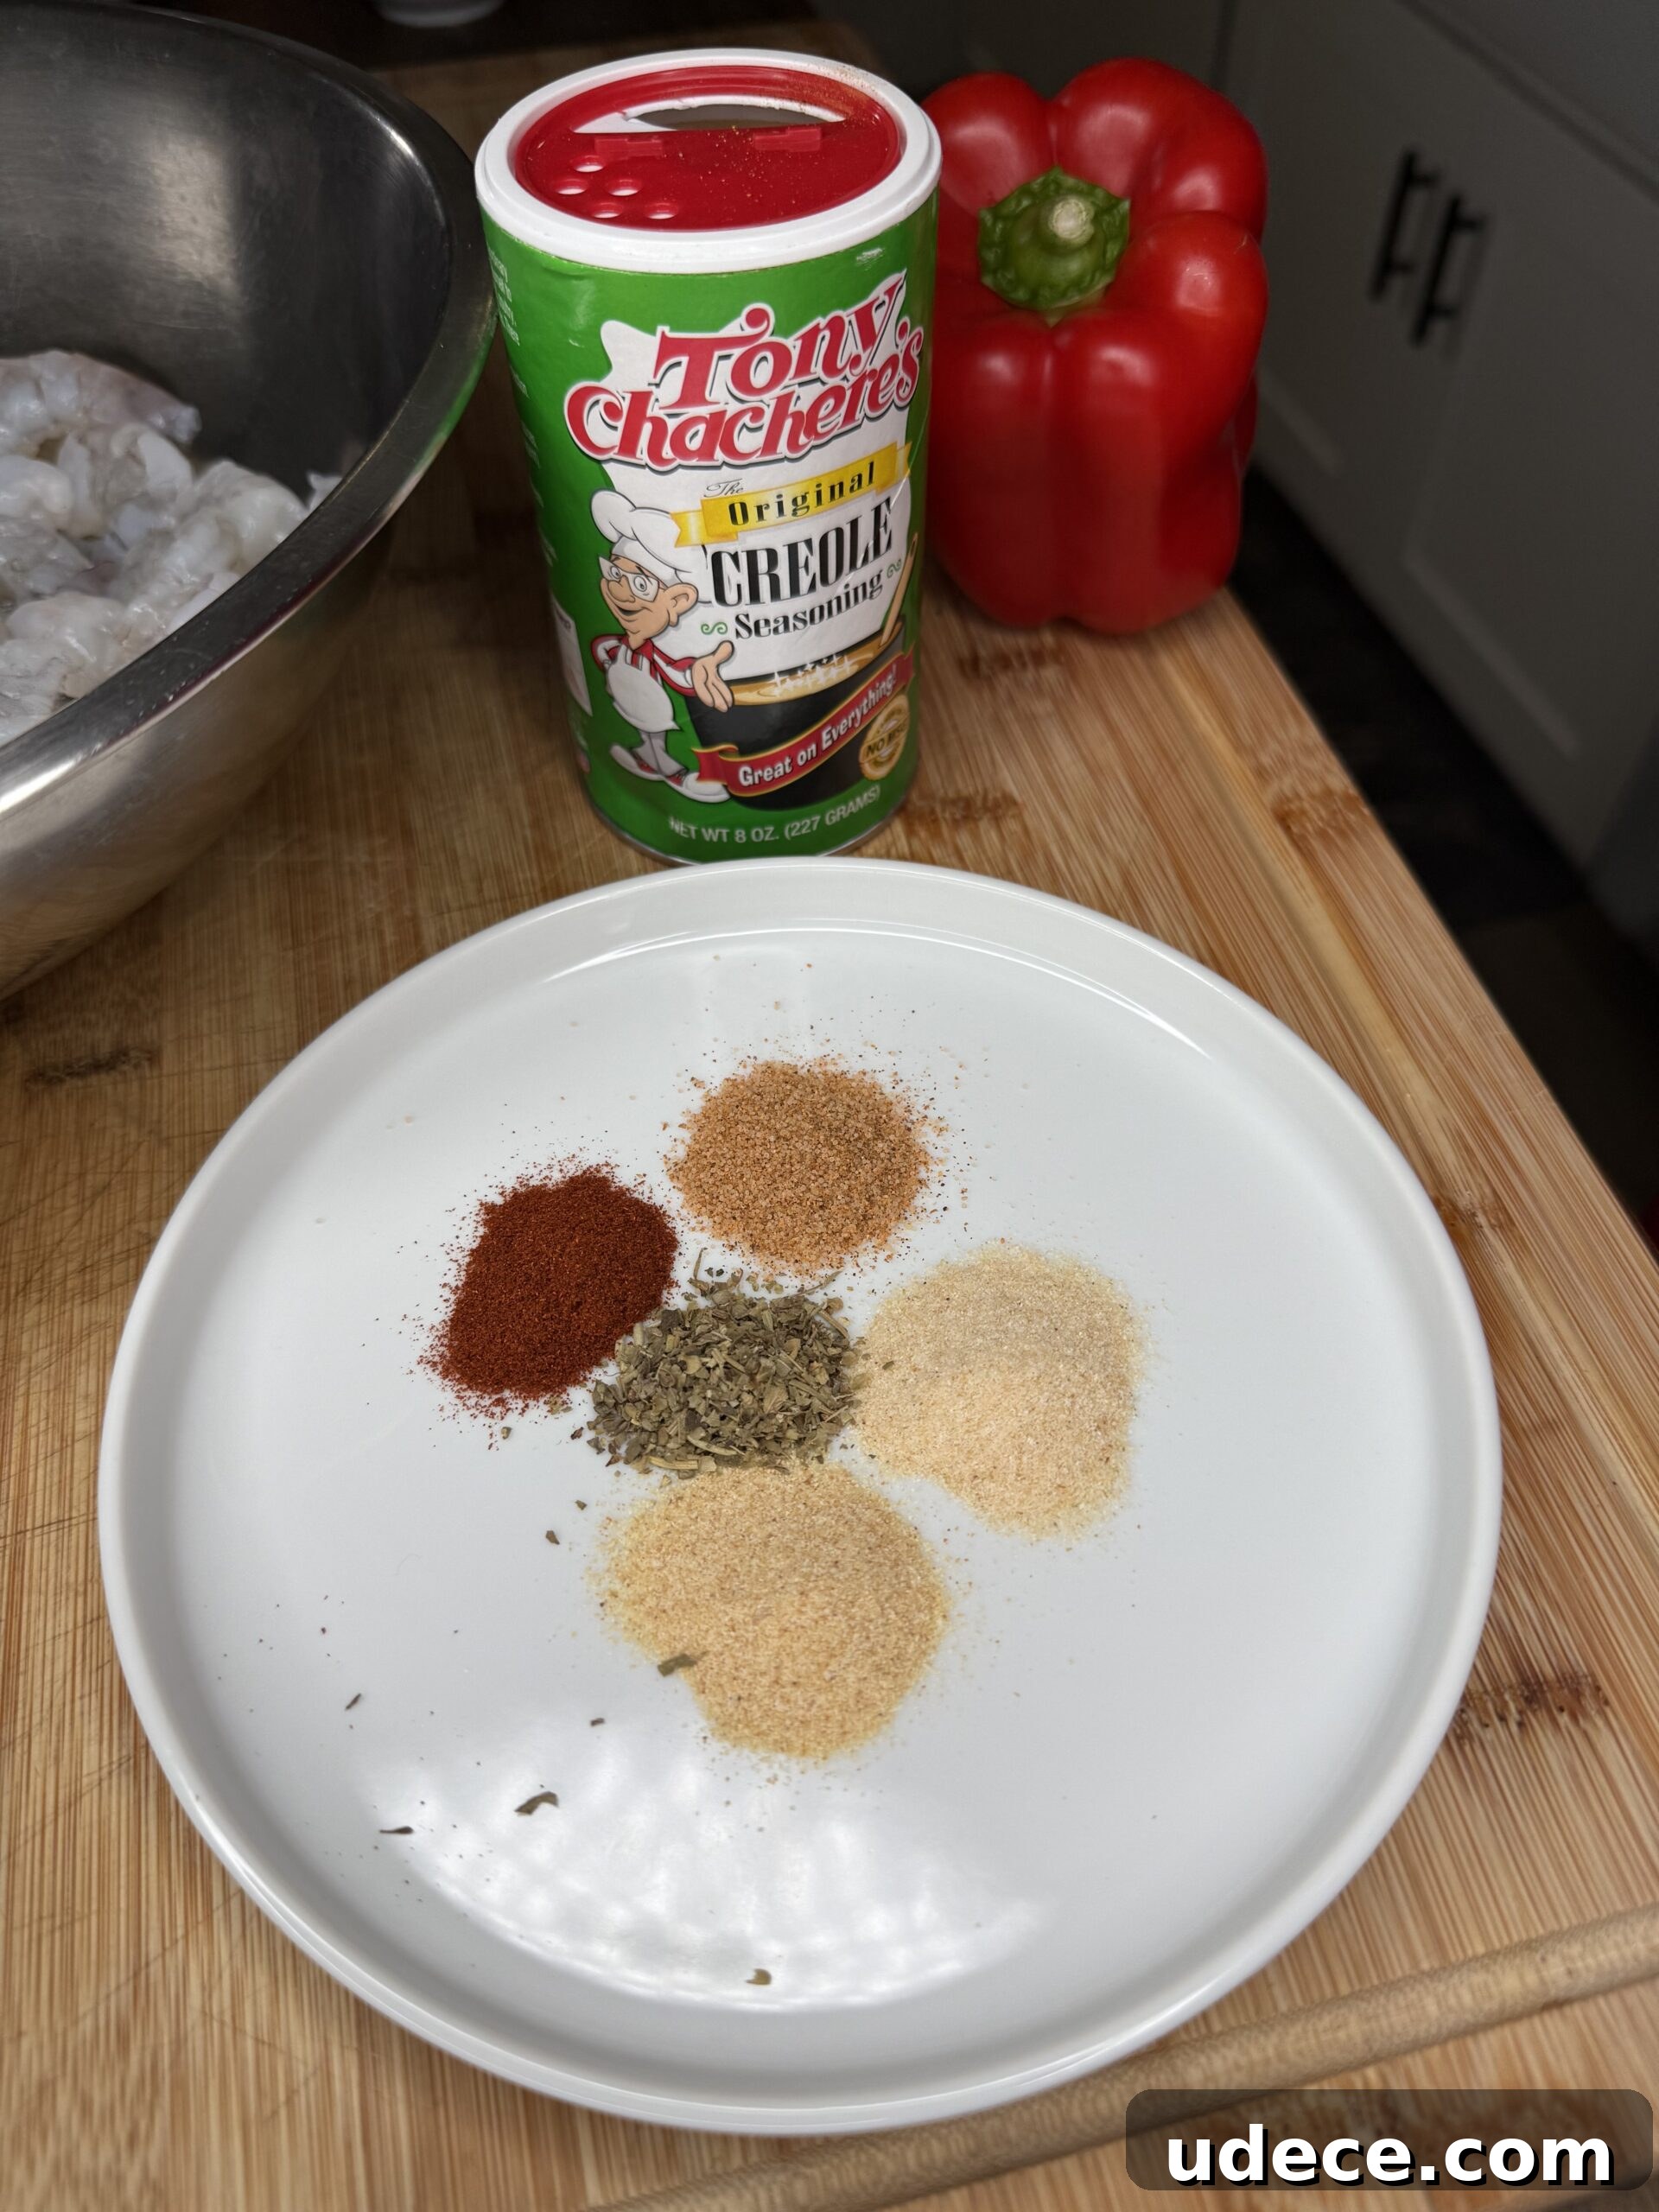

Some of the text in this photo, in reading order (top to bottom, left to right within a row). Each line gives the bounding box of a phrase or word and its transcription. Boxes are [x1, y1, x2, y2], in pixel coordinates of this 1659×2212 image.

[653, 276, 903, 410] Tony
[567, 321, 923, 467] Chachere's
[703, 478, 743, 498] The
[728, 461, 874, 526] Original
[711, 496, 893, 607] CREOLE
[734, 569, 883, 639] Seasoning
[739, 664, 897, 787] Great on Everything!
[865, 738, 885, 759] NO
[669, 783, 881, 844] NET WT 8 OZ. (227 GRAMS)
